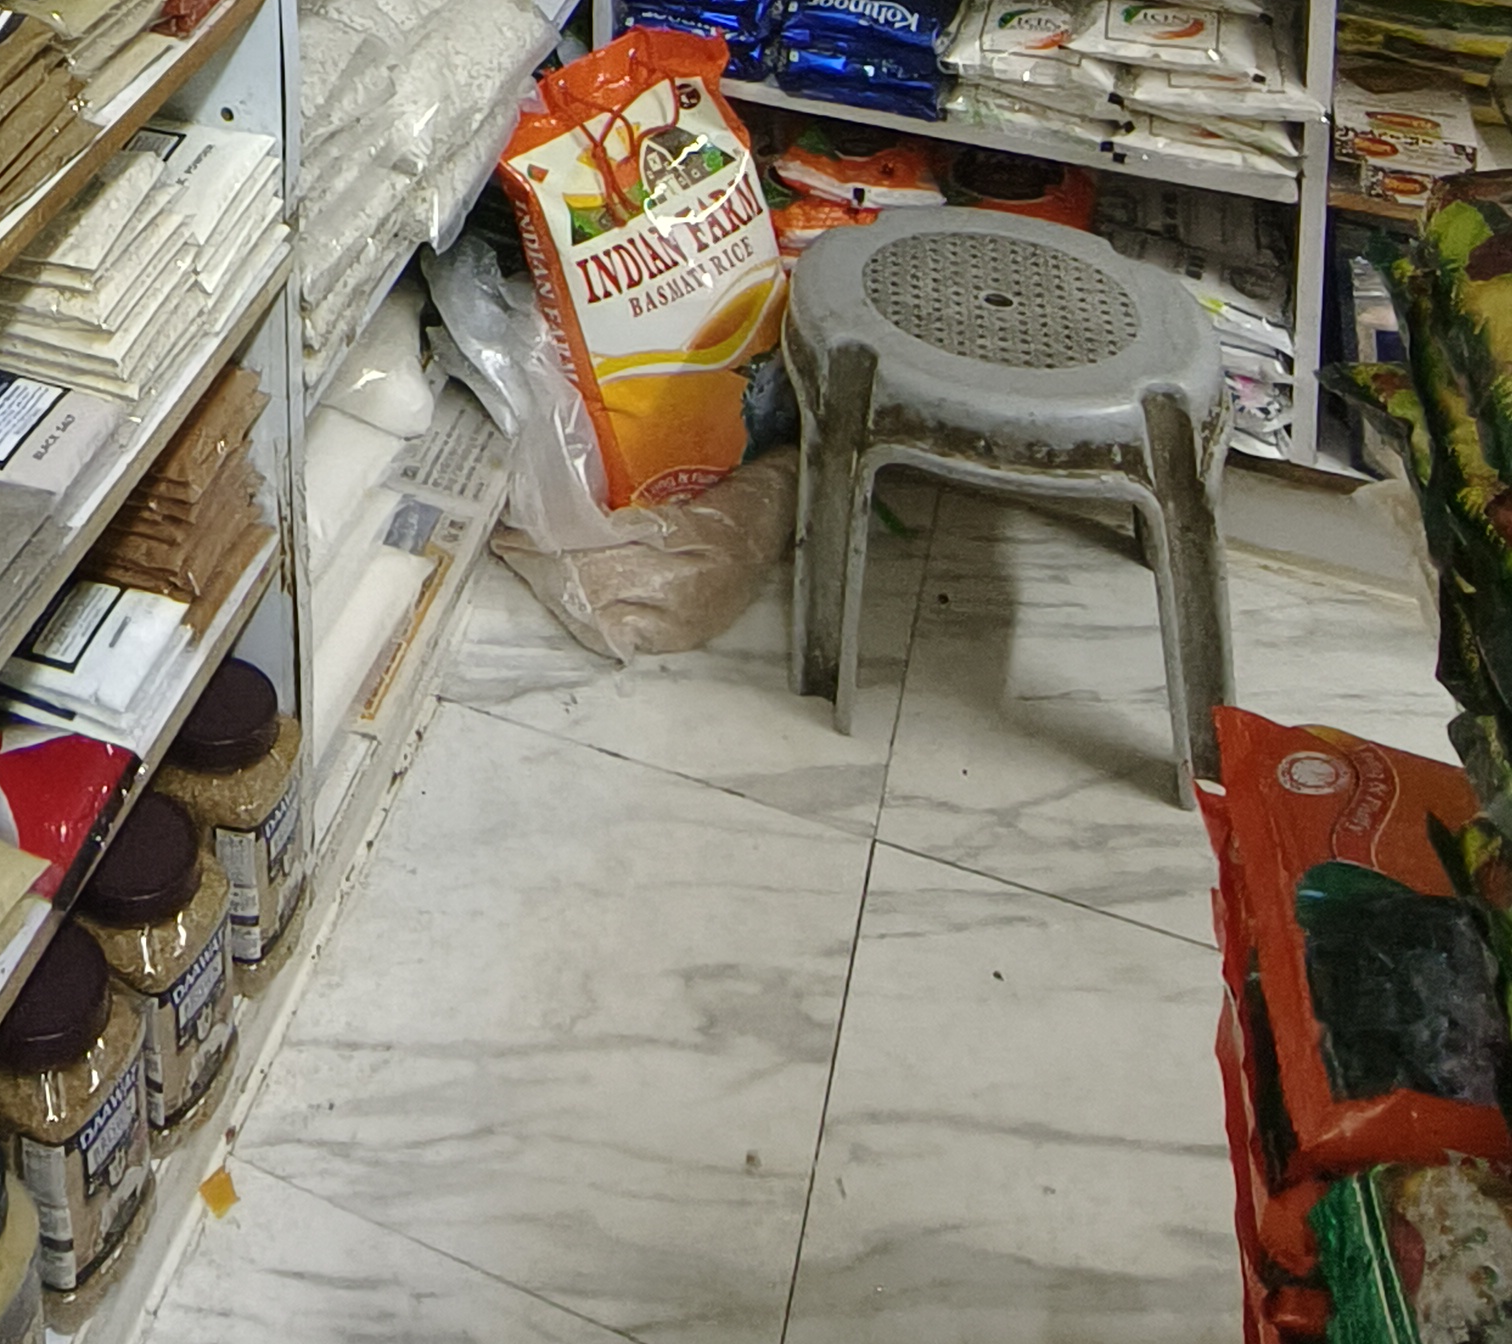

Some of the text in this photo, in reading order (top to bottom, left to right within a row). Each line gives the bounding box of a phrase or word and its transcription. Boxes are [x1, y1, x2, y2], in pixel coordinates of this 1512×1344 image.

[576, 171, 765, 305] INDIAN FARM
[627, 235, 755, 320] BASMATI RICE
[171, 924, 225, 1005] DAAWAT
[80, 1062, 139, 1148] DAAWAT
